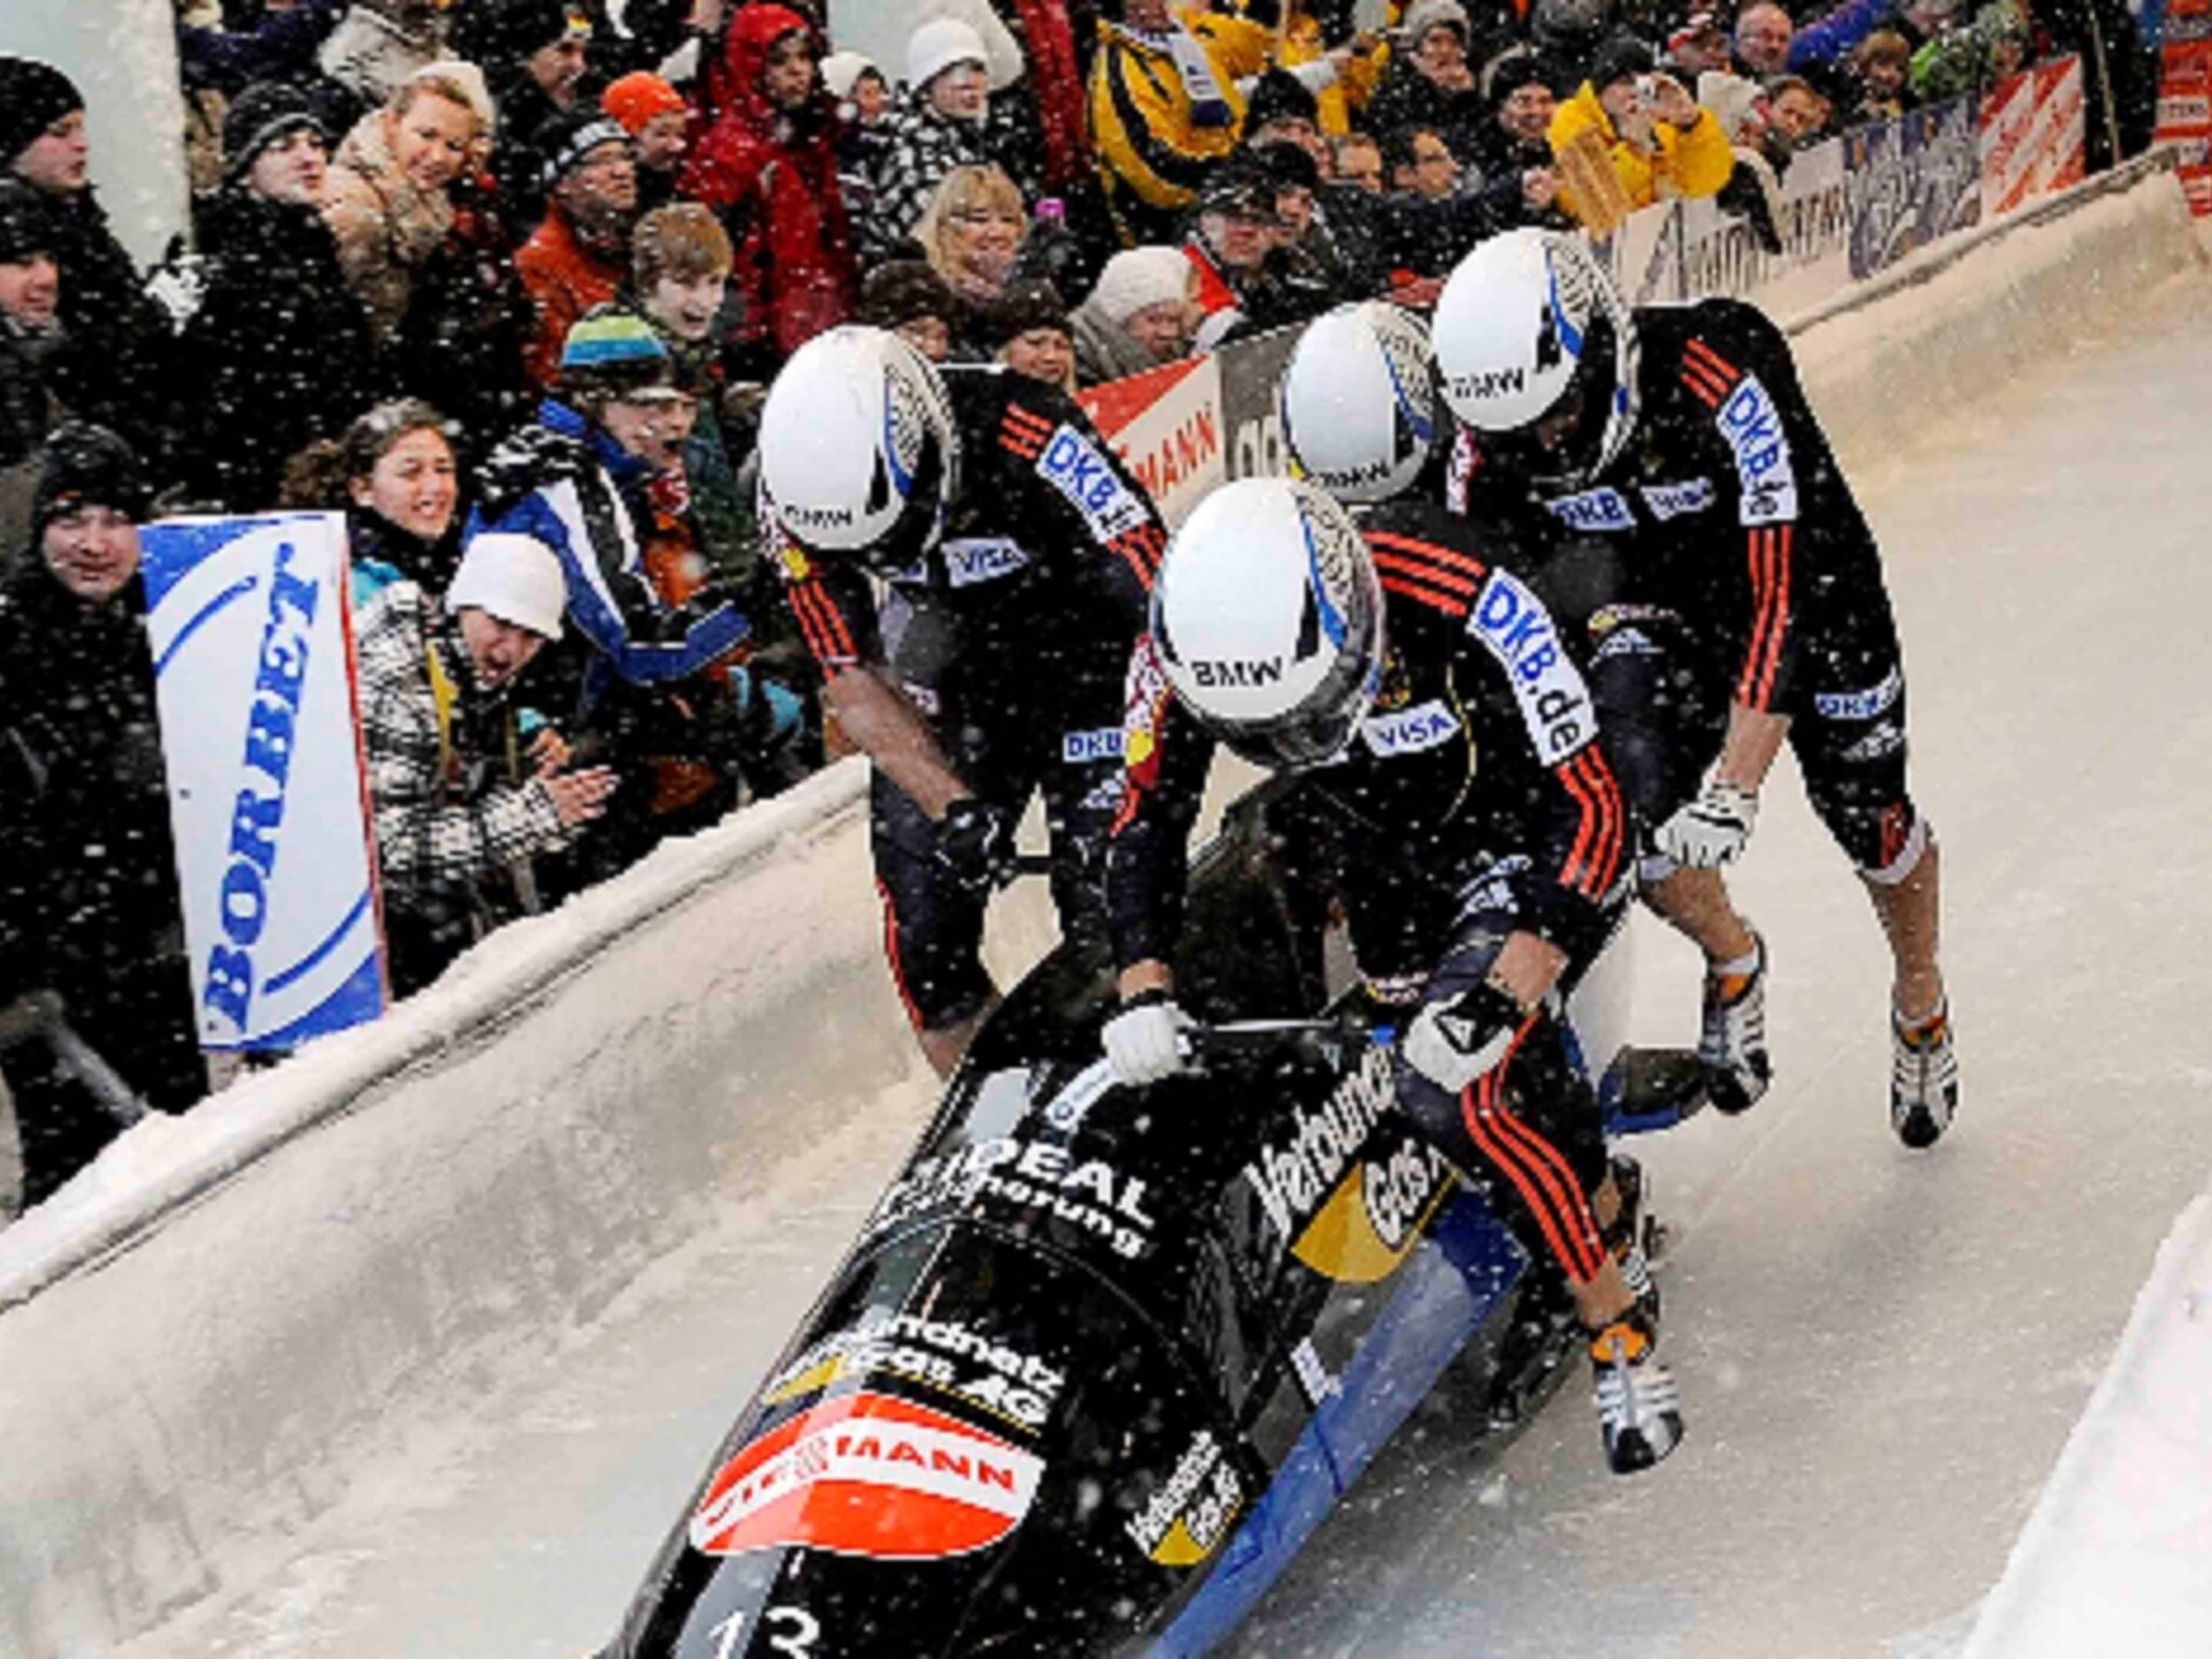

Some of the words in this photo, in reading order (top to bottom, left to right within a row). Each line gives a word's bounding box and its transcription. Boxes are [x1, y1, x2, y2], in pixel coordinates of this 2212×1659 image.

[1192, 656, 1282, 687] BMW
[1478, 581, 1584, 753] DKB.de
[1379, 715, 1452, 748] VISA
[204, 542, 320, 1035] BORBET
[708, 1606, 820, 1659] 13
